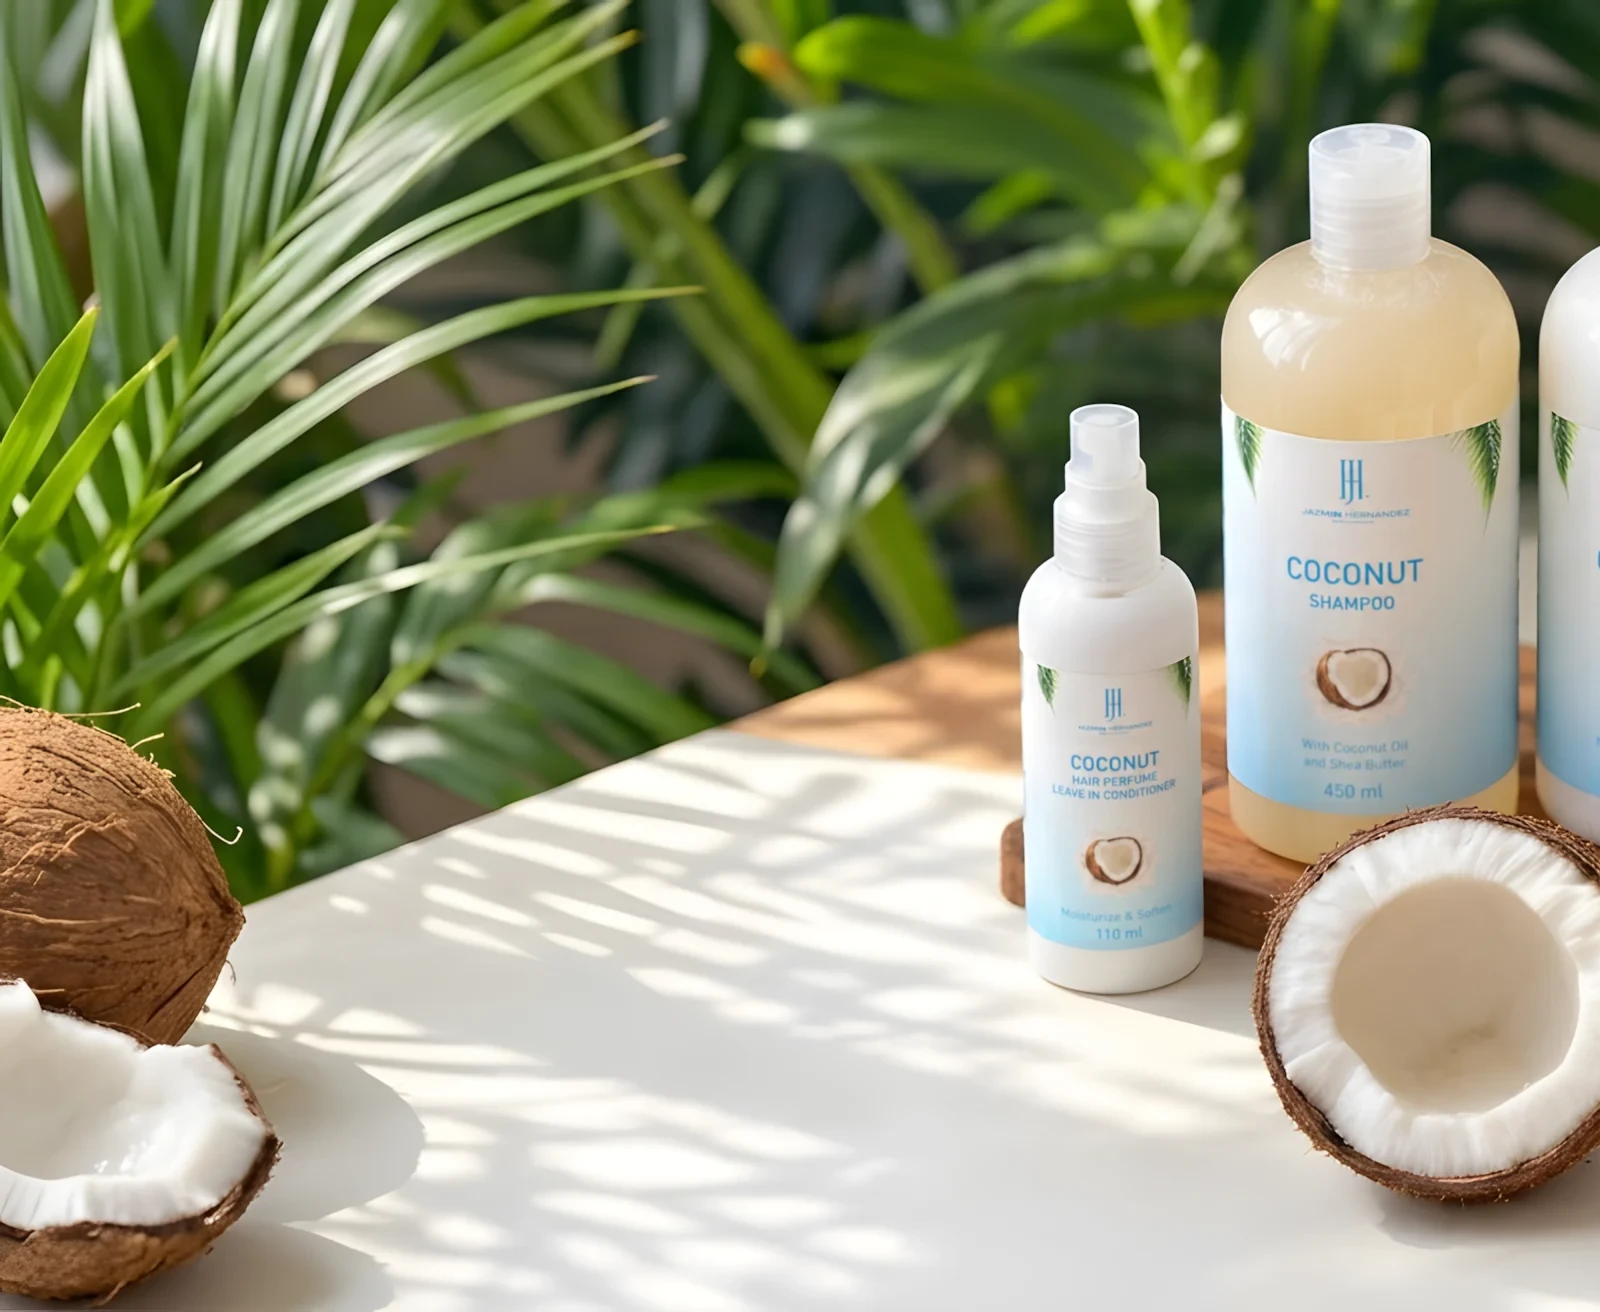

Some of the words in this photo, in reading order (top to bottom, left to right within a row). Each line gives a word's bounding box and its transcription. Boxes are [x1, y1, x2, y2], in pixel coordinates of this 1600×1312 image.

[1302, 508, 1342, 518] JAZMIN
[1345, 508, 1410, 519] HERNANDEZ
[1287, 556, 1423, 585] COCONUT
[1309, 593, 1395, 610] SHAMPOO
[1302, 738, 1330, 752] With
[1334, 742, 1387, 754] Coconut
[1391, 740, 1409, 752] Oil
[1071, 751, 1159, 772] COCONUT
[1304, 757, 1326, 768] and
[1330, 758, 1361, 770] Shea
[1365, 759, 1406, 770] Butter
[1072, 775, 1099, 786] HAIR
[1103, 771, 1157, 787] PERFUME
[1052, 784, 1085, 799] LEAVE
[1088, 789, 1100, 800] IN
[1103, 779, 1176, 800] CONDITIONER
[1324, 783, 1355, 799] 450
[1361, 784, 1383, 799] ml
[1061, 907, 1121, 922] Moisturize
[1125, 911, 1133, 920] &
[1138, 904, 1172, 918] Soften
[1097, 928, 1120, 940] 110
[1125, 926, 1143, 939] ml
